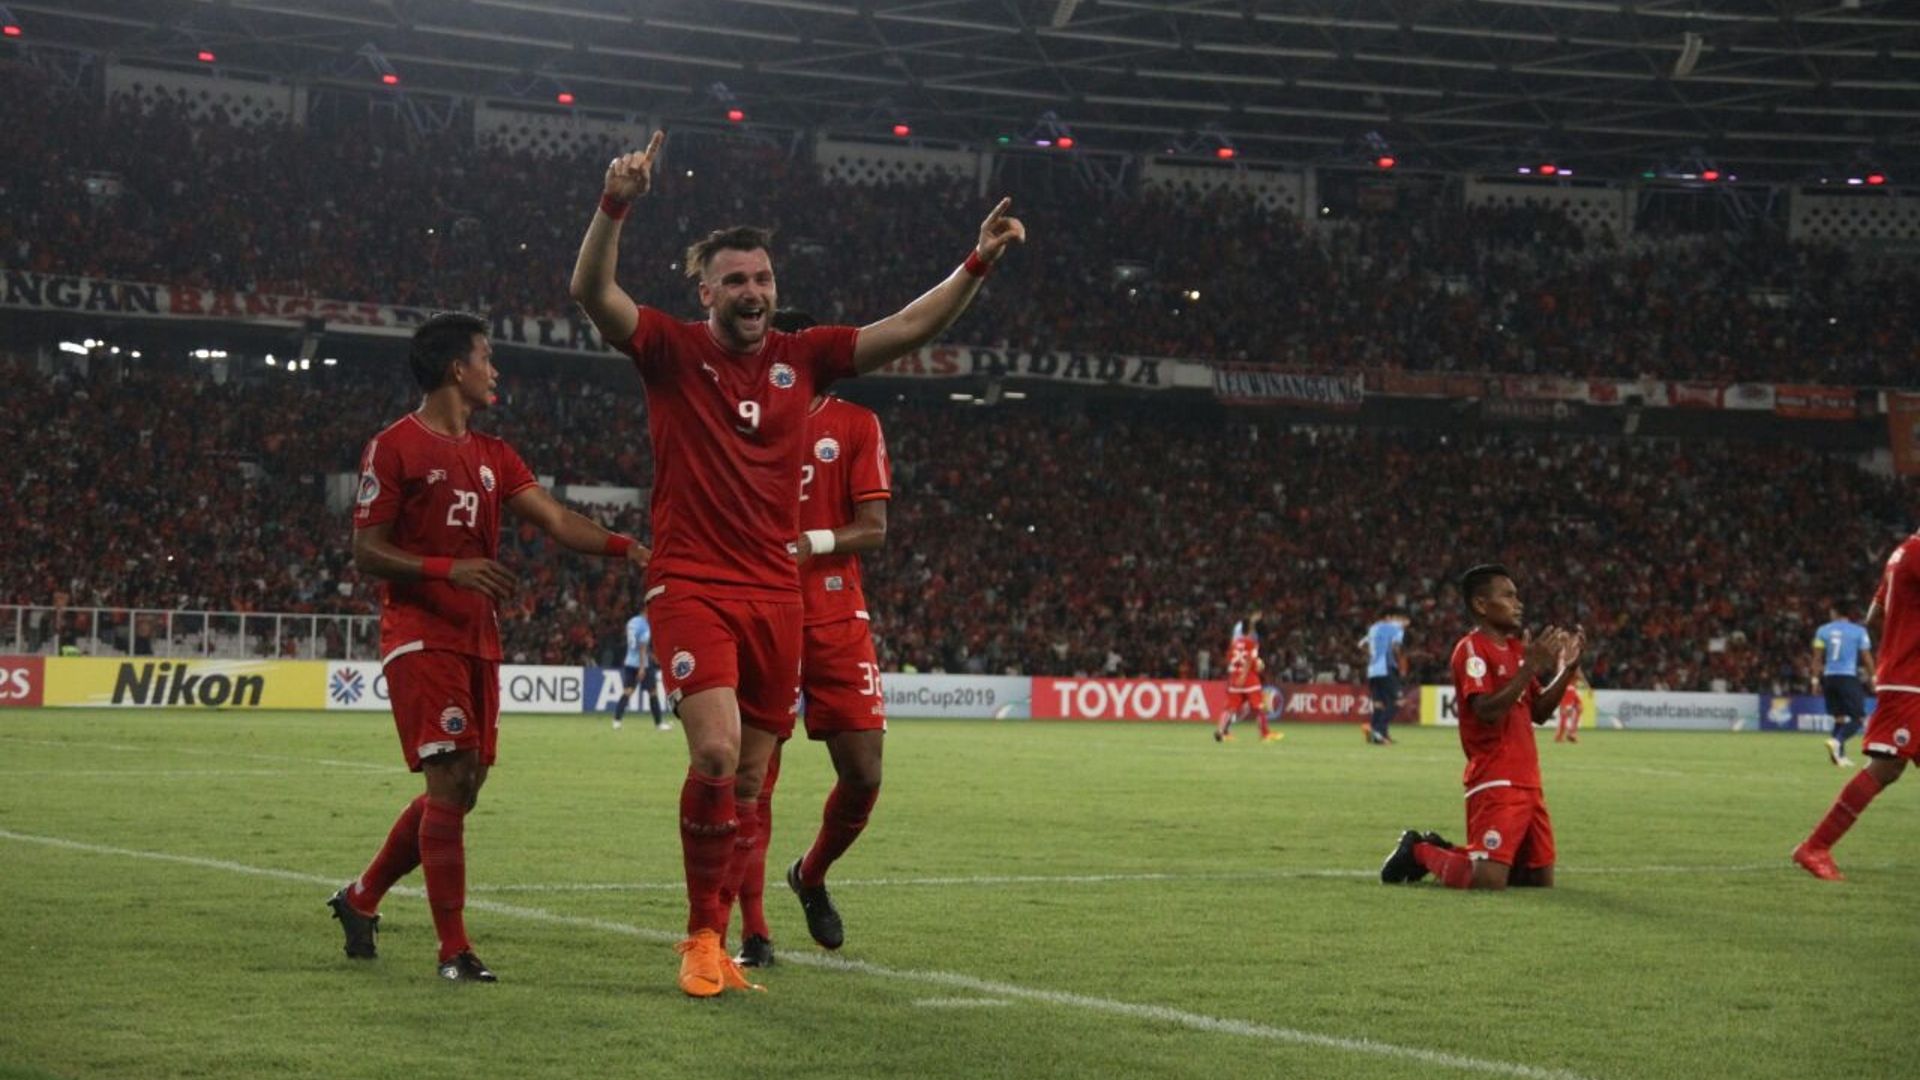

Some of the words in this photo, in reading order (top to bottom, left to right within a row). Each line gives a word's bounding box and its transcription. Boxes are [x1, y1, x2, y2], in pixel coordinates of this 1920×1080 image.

[735, 400, 761, 434] 9
[446, 488, 479, 527] 29
[1830, 637, 1842, 661] 7
[111, 662, 264, 706] Nikon
[510, 675, 580, 703] QNB
[1053, 681, 1211, 719] TOYOTA
[1285, 692, 1319, 714] AFC
[1320, 693, 1355, 715] CUP
